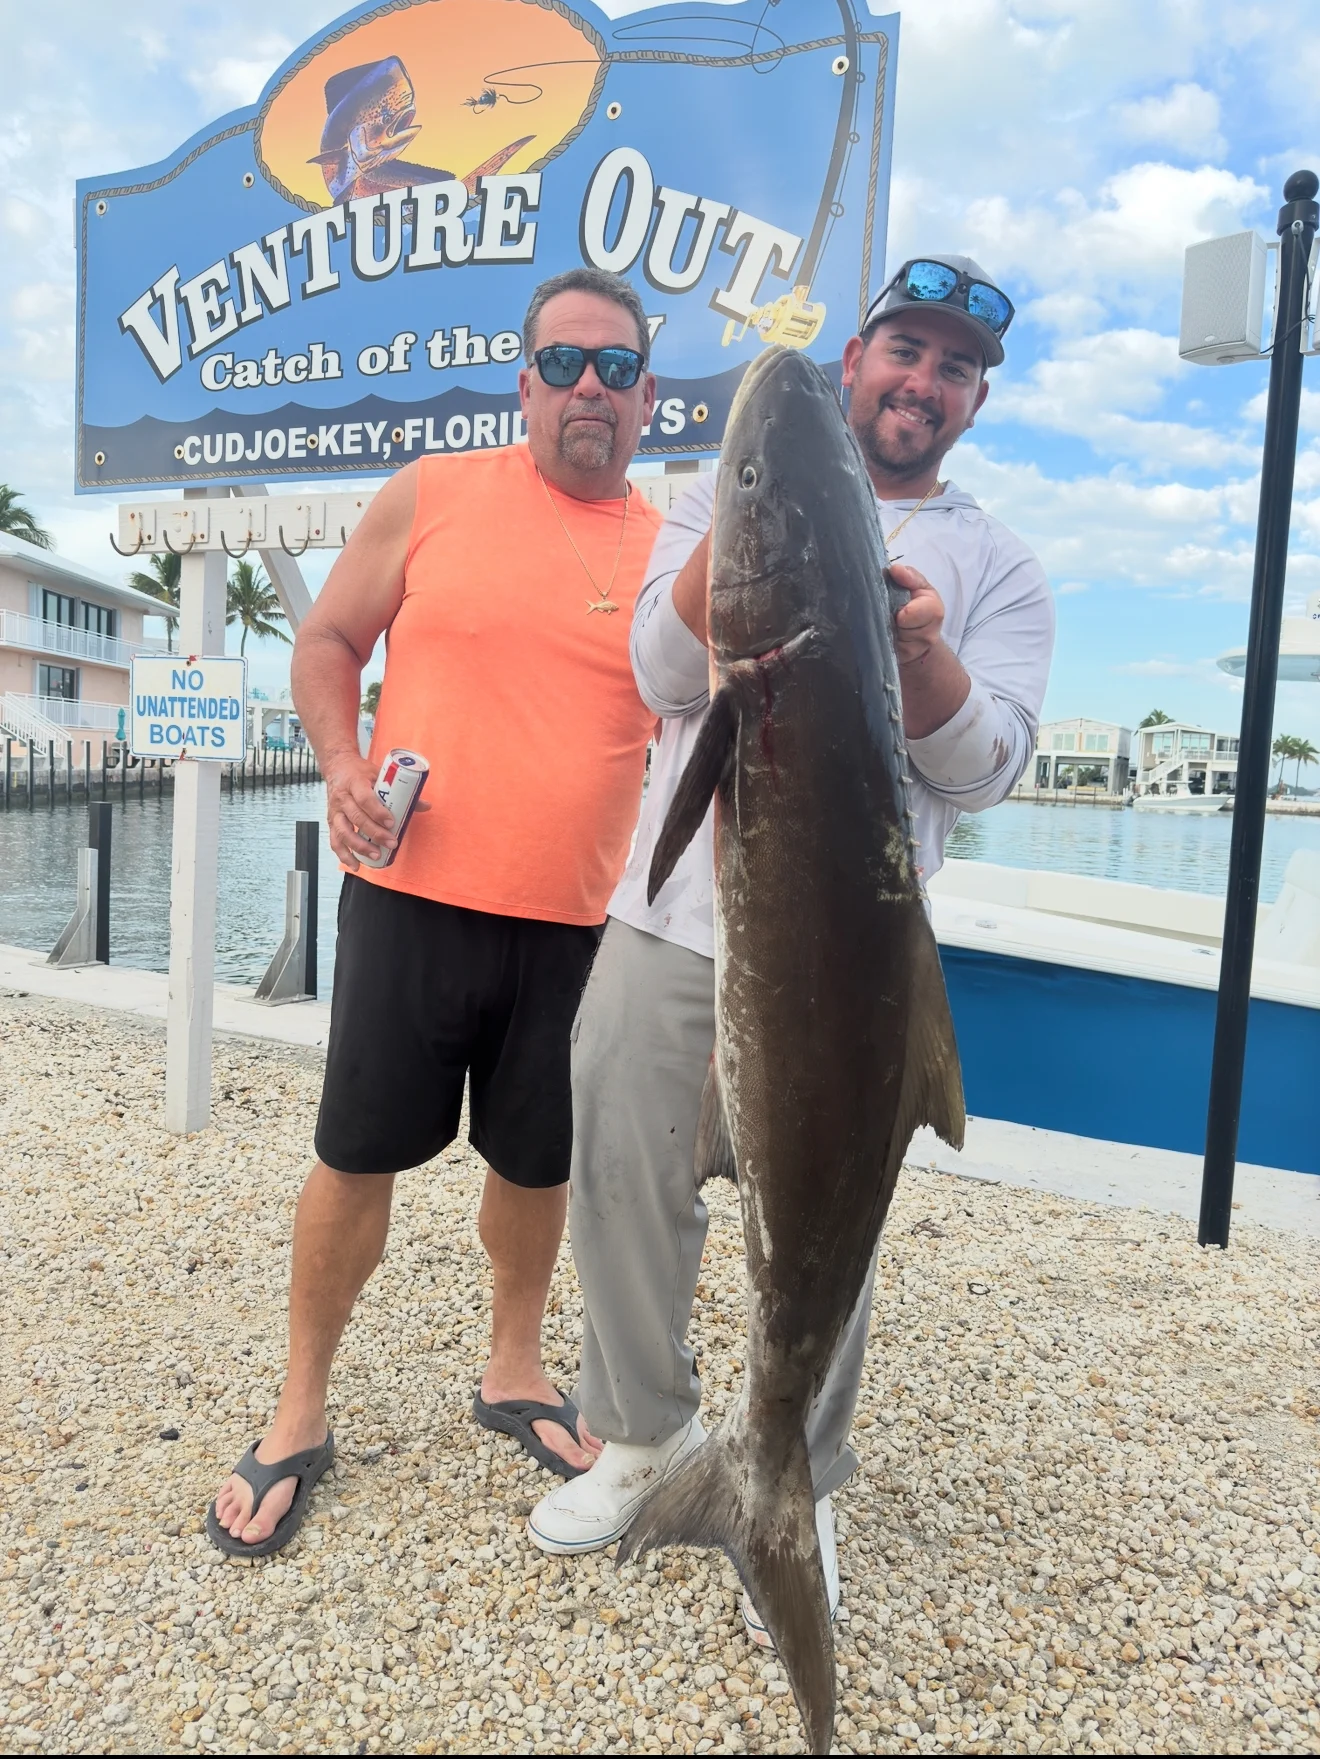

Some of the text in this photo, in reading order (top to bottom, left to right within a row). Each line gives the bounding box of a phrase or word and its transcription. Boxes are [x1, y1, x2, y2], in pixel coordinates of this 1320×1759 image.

[118, 147, 804, 384] VENTURE OUT
[200, 325, 522, 392] Catch of the
[183, 426, 307, 466] CUDJOE
[318, 420, 392, 461] KEY,
[403, 411, 529, 451] FLORID
[172, 669, 204, 691] NO
[136, 695, 240, 720] UNATTENDED
[149, 723, 226, 748] BOATS
